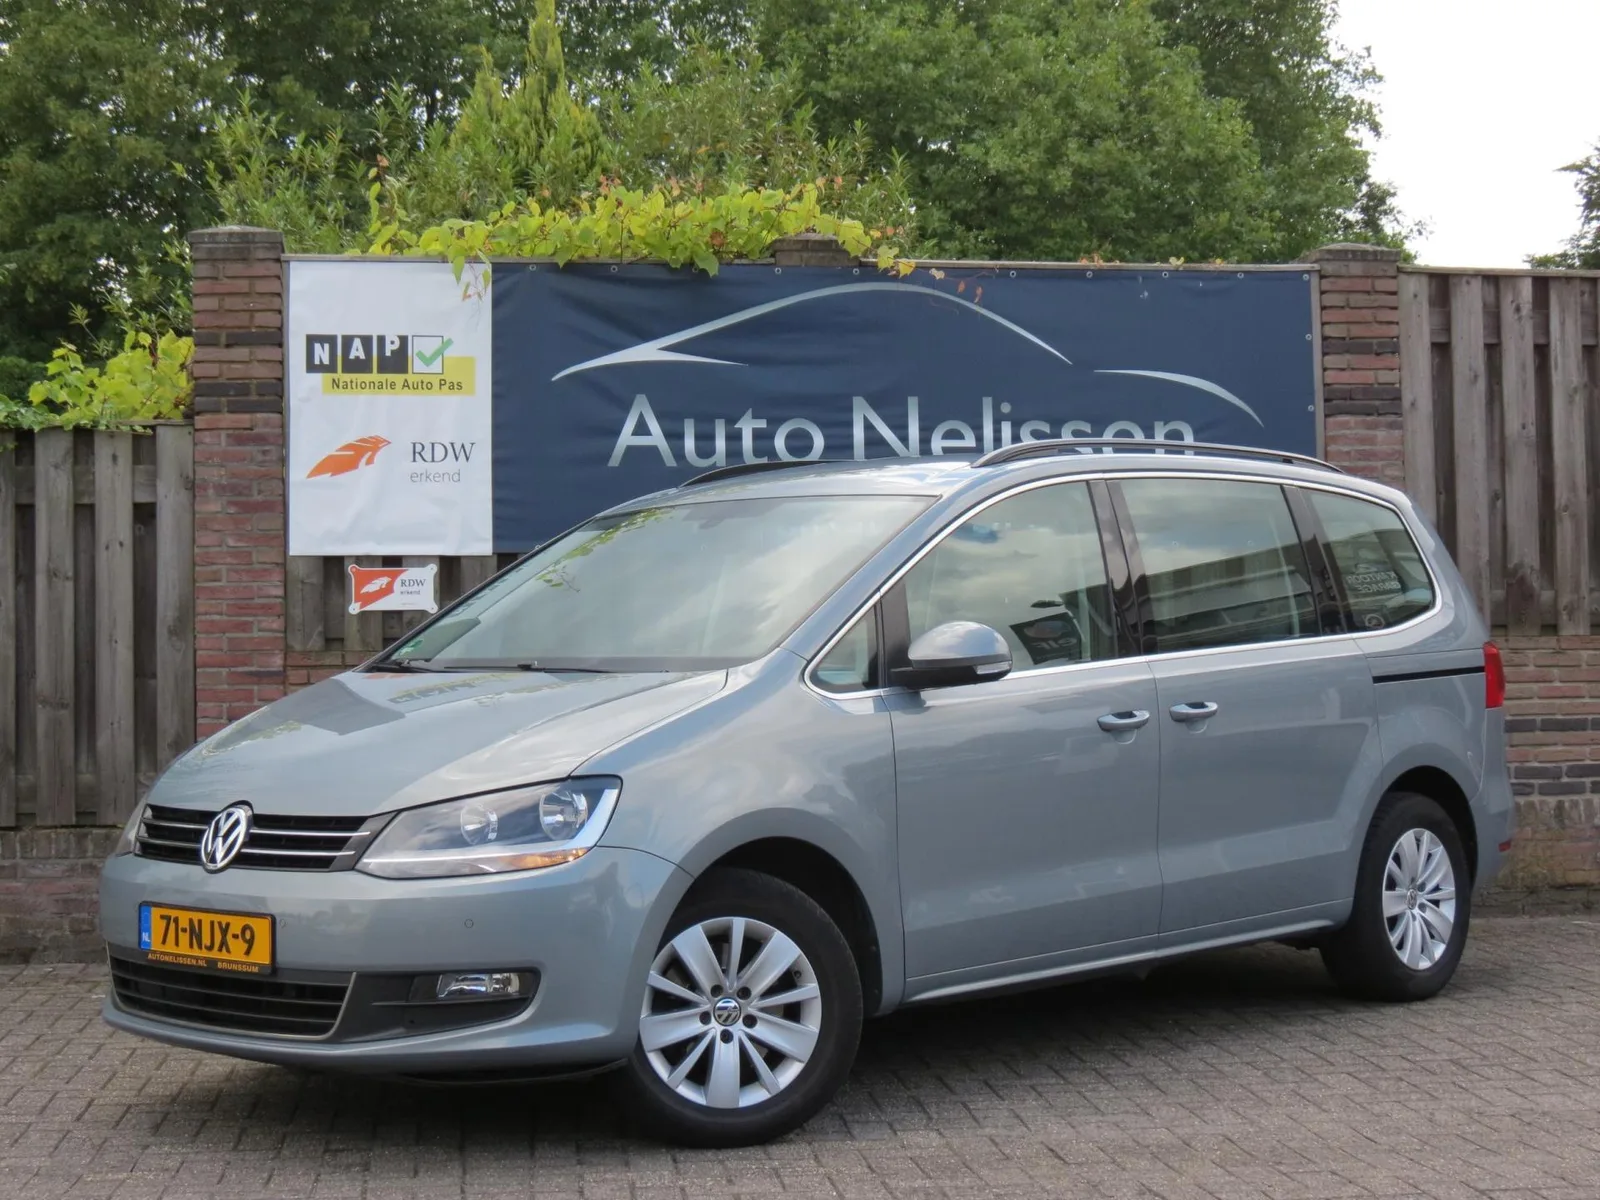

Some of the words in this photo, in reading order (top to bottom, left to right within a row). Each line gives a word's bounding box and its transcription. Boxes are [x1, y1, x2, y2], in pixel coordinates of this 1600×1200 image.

[314, 335, 400, 365] NAP
[331, 378, 397, 390] Nationale
[402, 379, 433, 391] Auto
[439, 379, 463, 391] Pas
[607, 394, 825, 467] Auto
[411, 442, 476, 463] RDW
[410, 469, 461, 483] erkend
[400, 579, 426, 588] RDW
[142, 932, 151, 942] NL
[160, 914, 255, 956] 71-NJX-9
[147, 953, 207, 967] AUTONELISSEN.NL
[217, 962, 259, 973] BRUNSSUM
